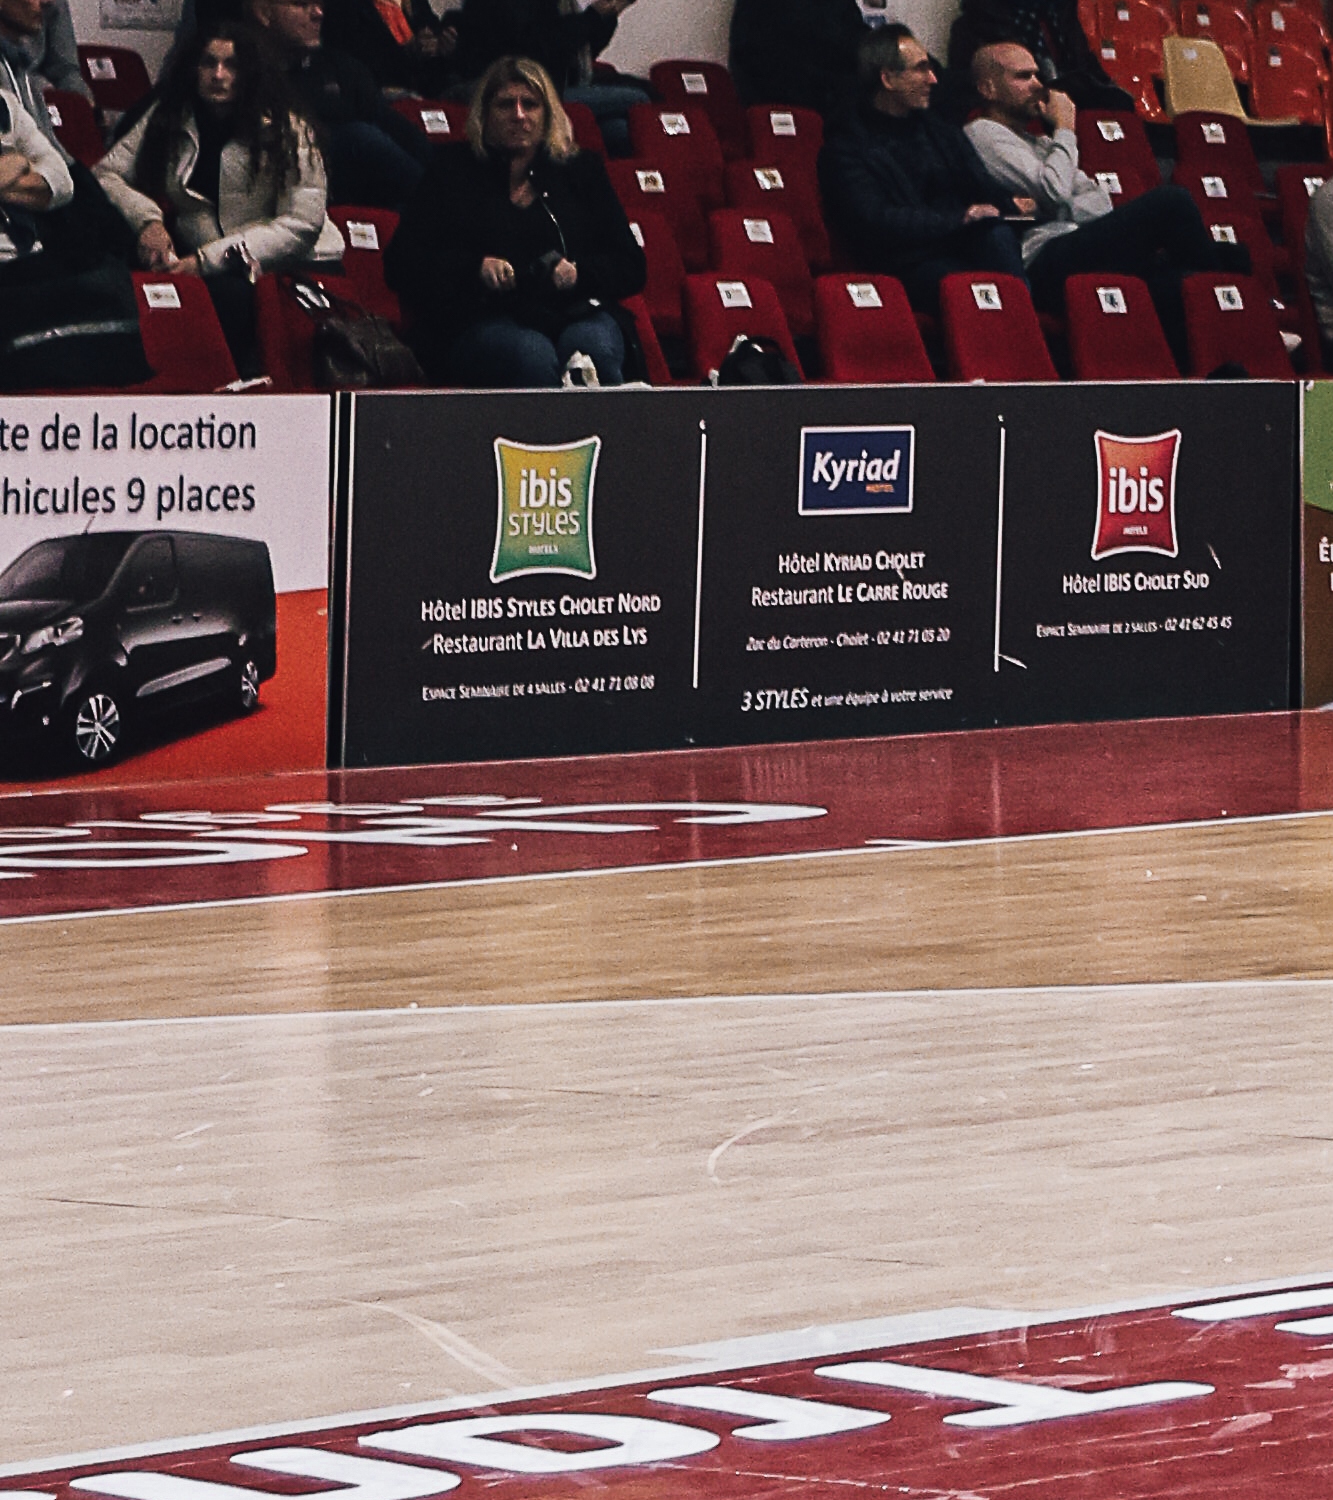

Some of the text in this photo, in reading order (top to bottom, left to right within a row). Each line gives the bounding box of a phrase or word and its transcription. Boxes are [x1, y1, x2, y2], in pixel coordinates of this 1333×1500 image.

[41, 412, 81, 450] de
[93, 412, 118, 450] la
[131, 412, 256, 449] location
[812, 449, 901, 491] Kyriad
[3, 474, 256, 521] hicules 9 places
[520, 467, 572, 508] ibis
[1108, 466, 1164, 515] ibis
[778, 552, 819, 574] Hôtel
[1062, 572, 1100, 594] Hôtel
[1104, 573, 1130, 592] IBIS
[751, 586, 834, 607] Restaurant
[421, 599, 467, 622] Hôtel
[471, 597, 503, 619] IBIS
[433, 632, 523, 654] Restaurant
[527, 629, 545, 650] LA
[741, 691, 752, 711] 3
[755, 687, 810, 711] STYLES
